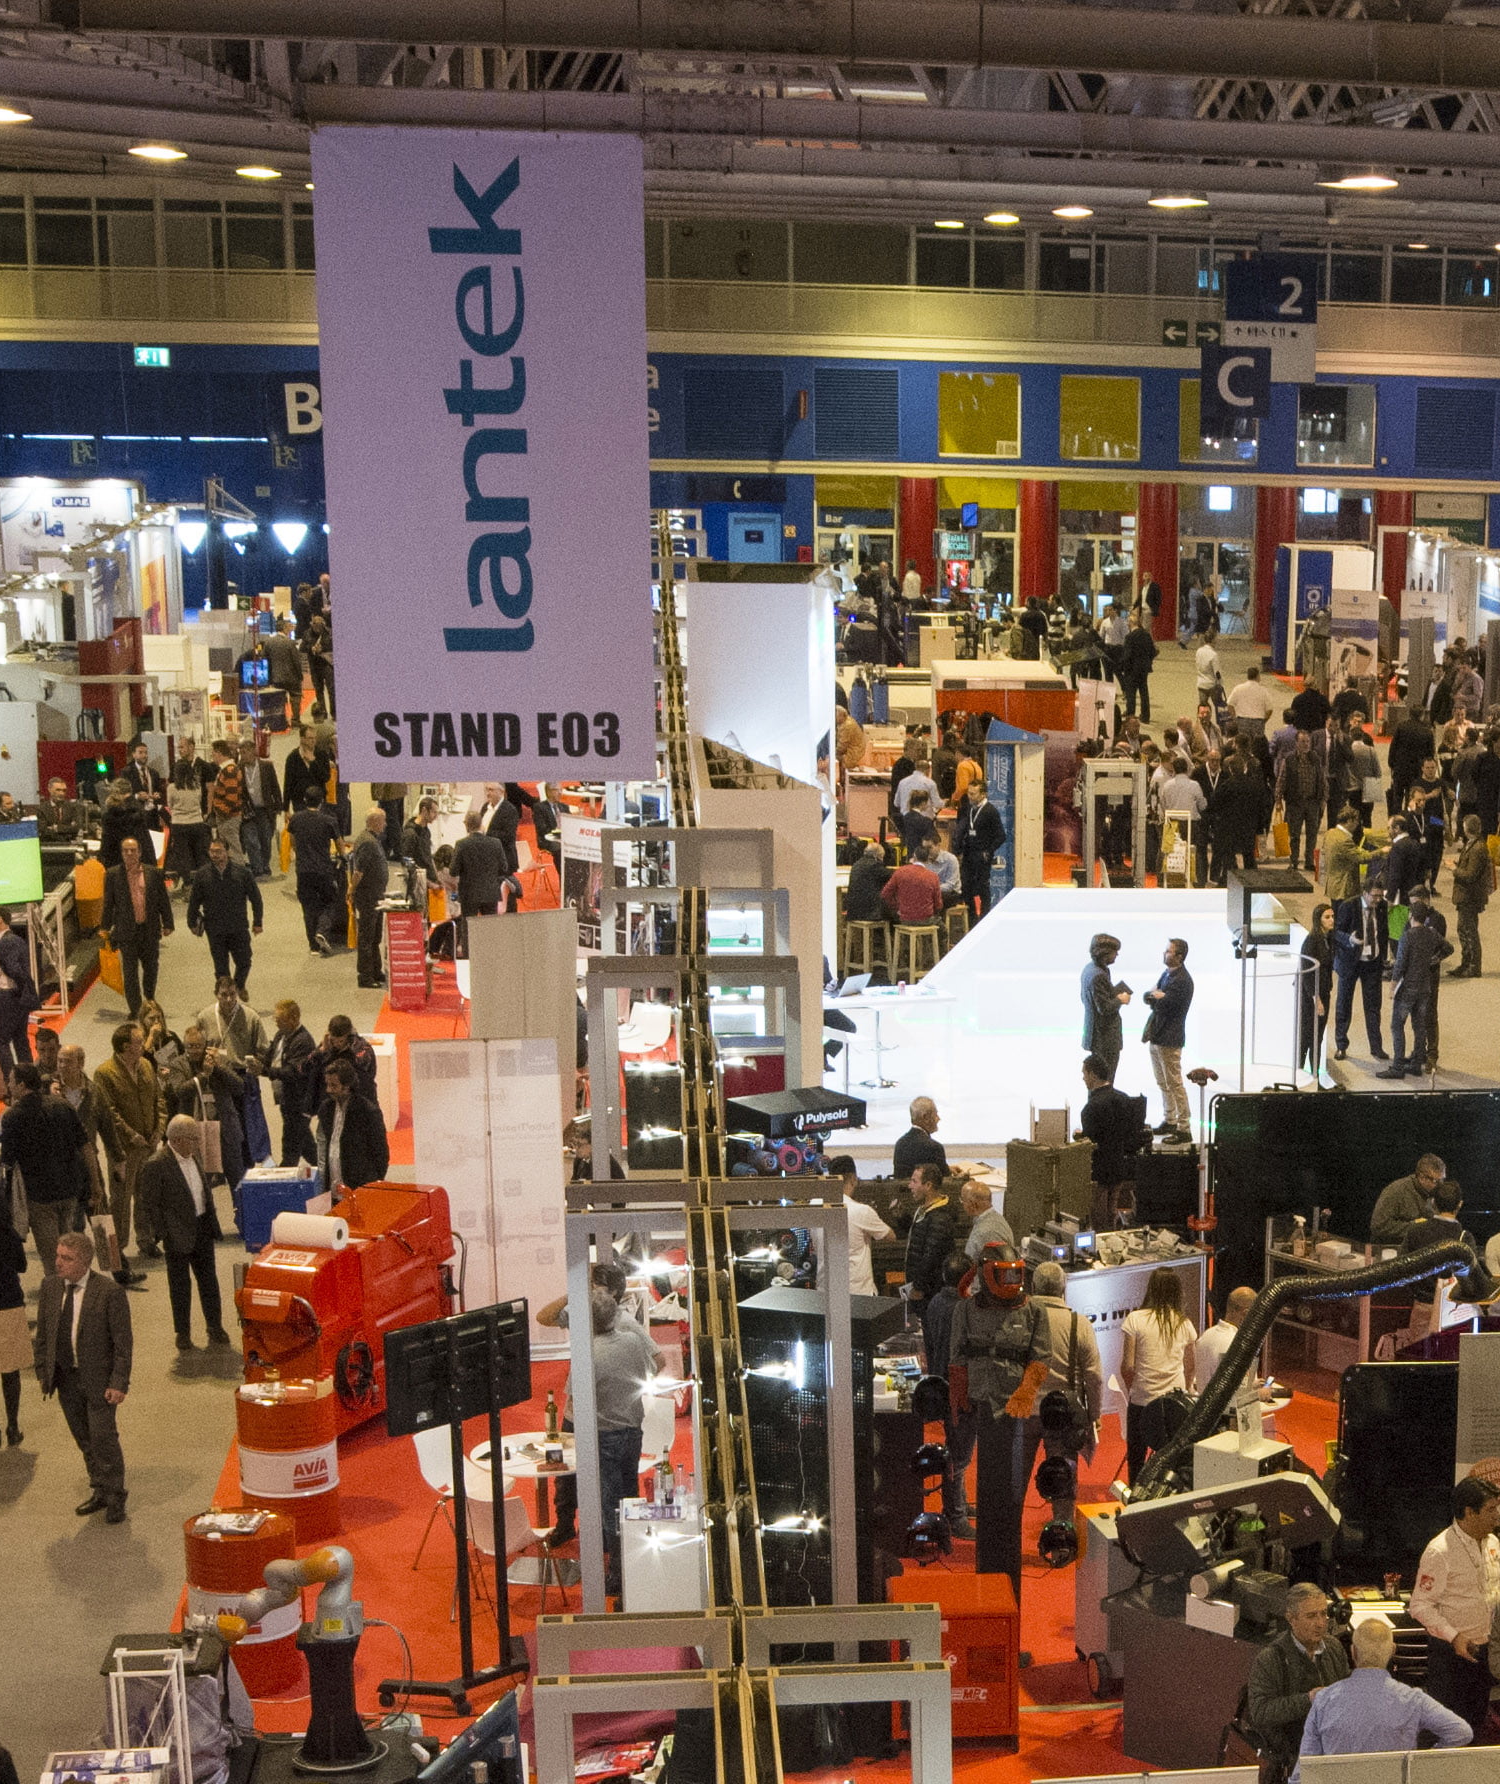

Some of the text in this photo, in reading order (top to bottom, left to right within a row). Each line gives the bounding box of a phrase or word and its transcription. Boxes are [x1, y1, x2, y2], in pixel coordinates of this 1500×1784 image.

[1278, 276, 1304, 315] 2
[426, 154, 535, 654] lantek
[1217, 356, 1257, 407] C
[284, 382, 322, 435] B
[371, 711, 622, 759] STAND E03
[805, 1108, 849, 1126] Pulysold
